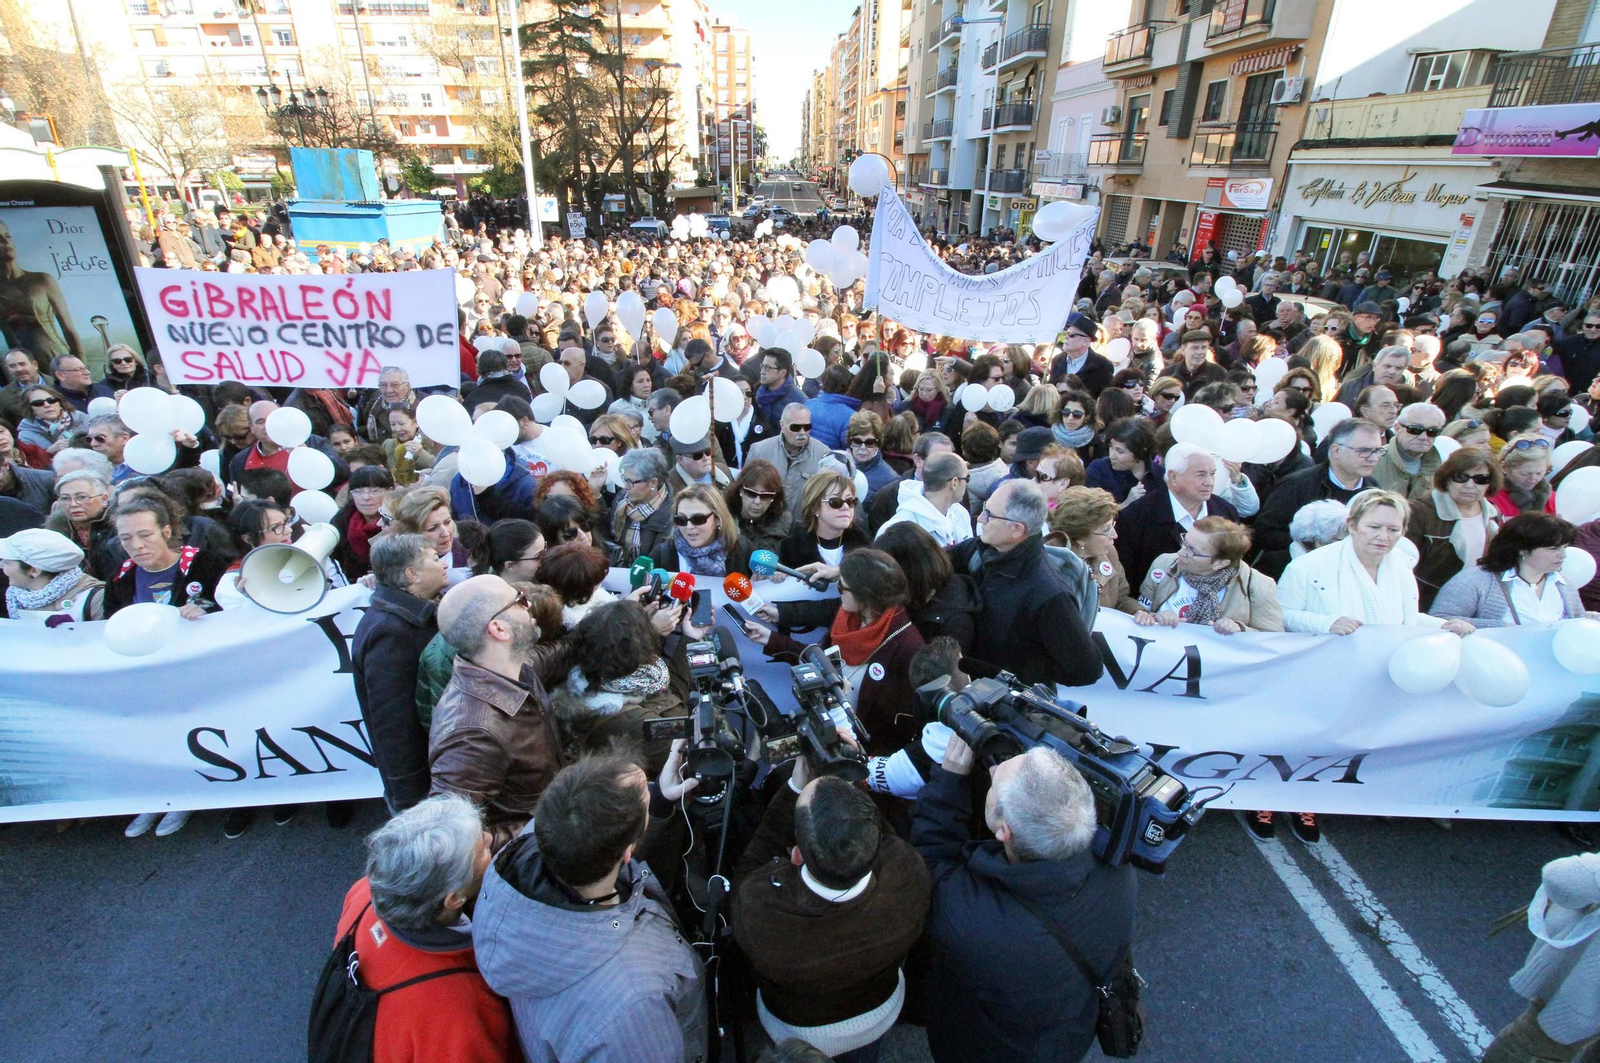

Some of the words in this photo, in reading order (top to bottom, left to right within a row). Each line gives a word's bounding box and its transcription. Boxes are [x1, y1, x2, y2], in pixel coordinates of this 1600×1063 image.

[1012, 202, 1034, 210] ORO
[1349, 180, 1368, 205] La
[1422, 182, 1471, 208] Moguer
[45, 218, 84, 234] Dior
[49, 241, 109, 280] j'adore
[879, 250, 1042, 327] COMPLETOS
[167, 321, 268, 347] NUEVO
[277, 320, 405, 348] CENTRO
[416, 323, 454, 349] DE
[181, 349, 305, 383] SALUD
[325, 348, 383, 386] YA
